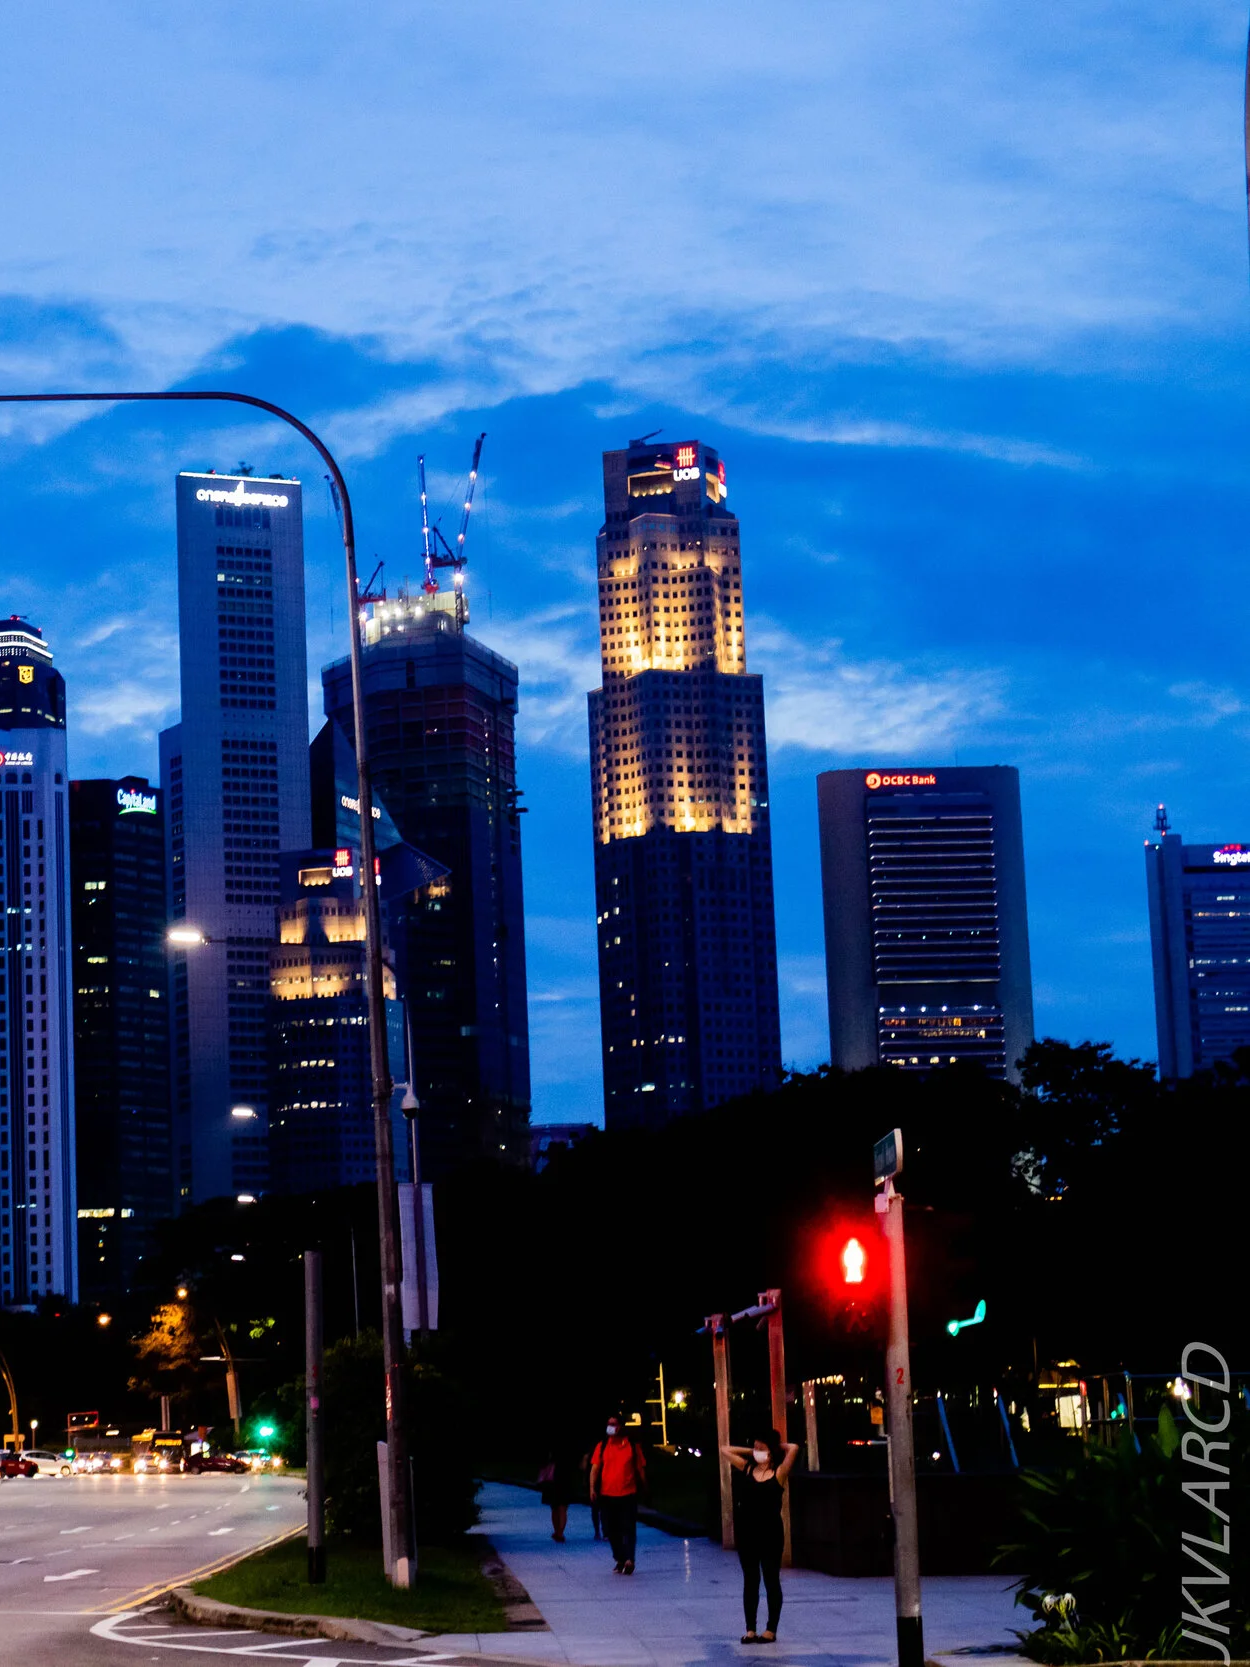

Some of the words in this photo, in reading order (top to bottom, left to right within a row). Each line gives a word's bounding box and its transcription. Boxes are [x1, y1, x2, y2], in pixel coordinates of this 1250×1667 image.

[673, 467, 700, 481] UOB
[882, 775, 911, 786] OCBC
[912, 774, 937, 785] Bank
[896, 1367, 904, 1385] 2
